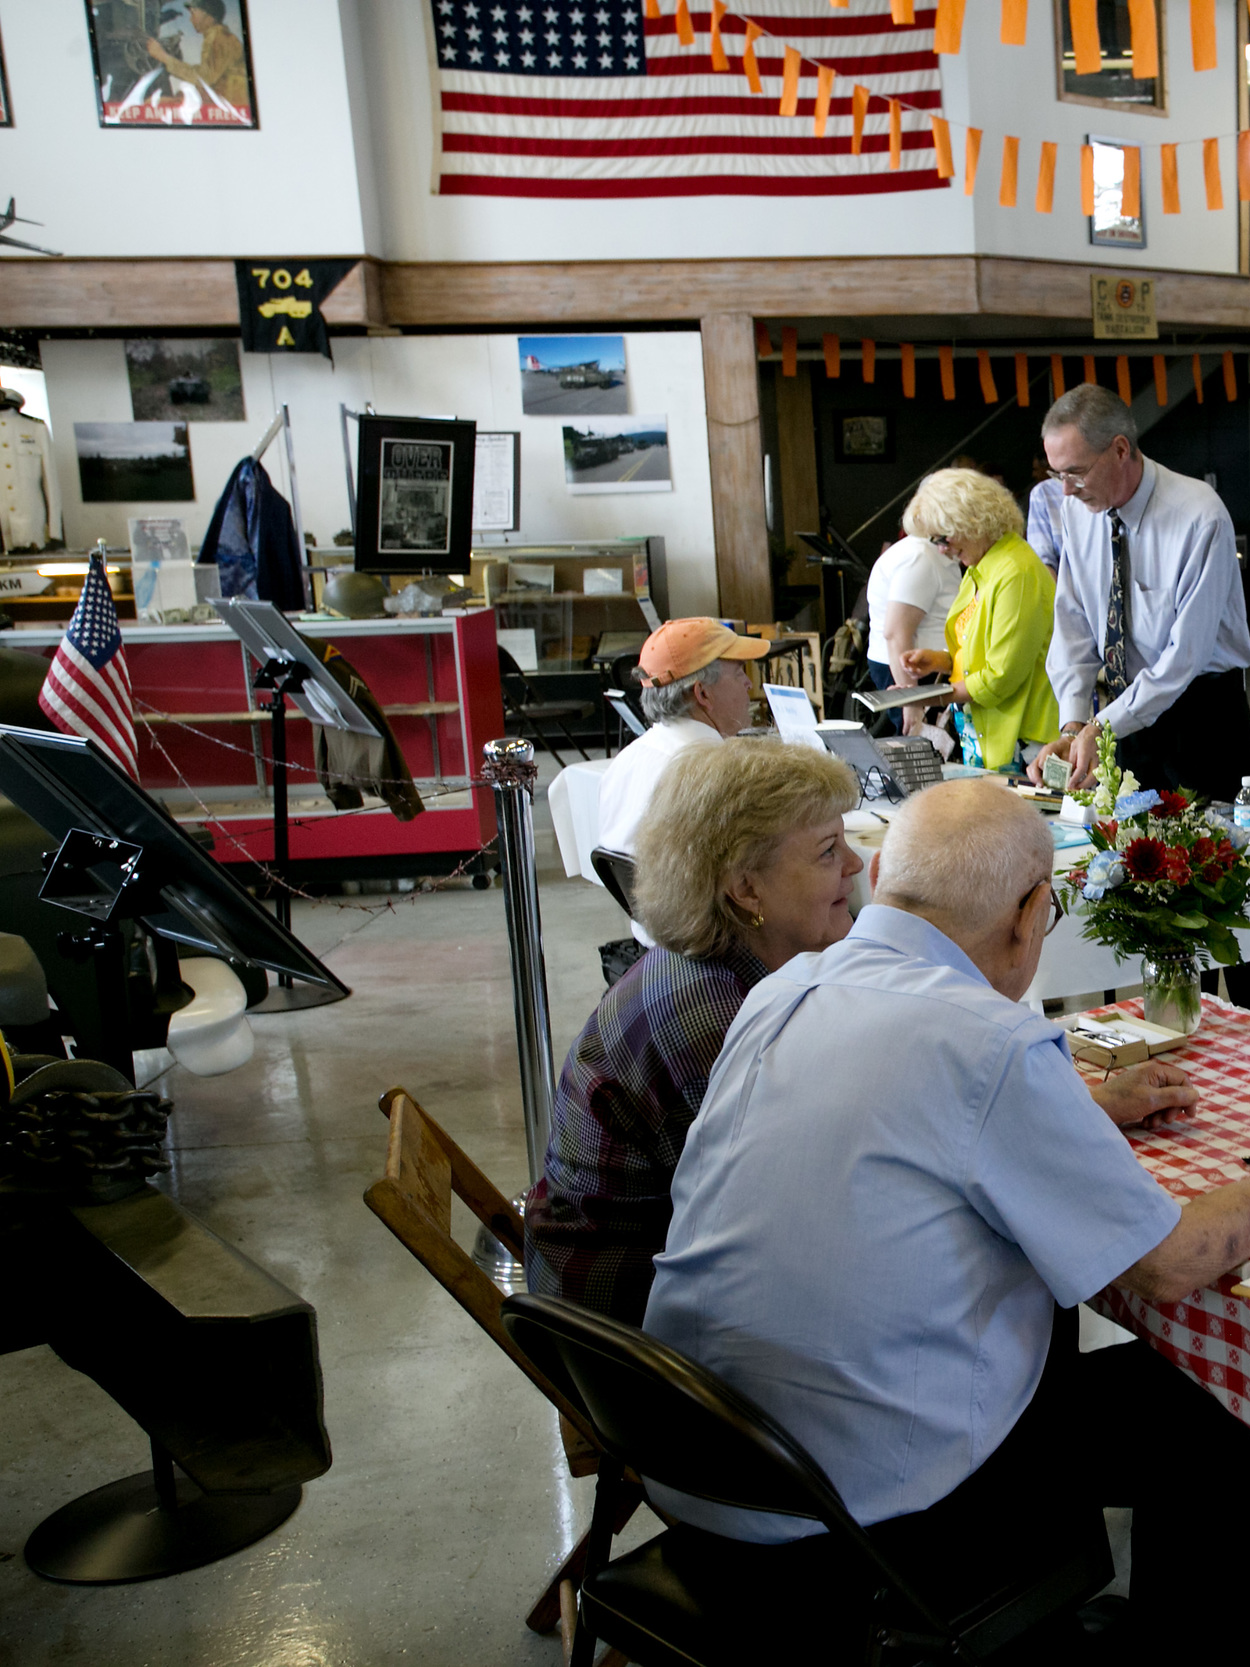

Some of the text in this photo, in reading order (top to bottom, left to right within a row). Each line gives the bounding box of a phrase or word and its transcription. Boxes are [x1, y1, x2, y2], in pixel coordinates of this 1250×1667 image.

[252, 268, 313, 289] 704
[1097, 280, 1107, 300] C
[276, 326, 295, 346] A
[391, 443, 443, 468] OVER
